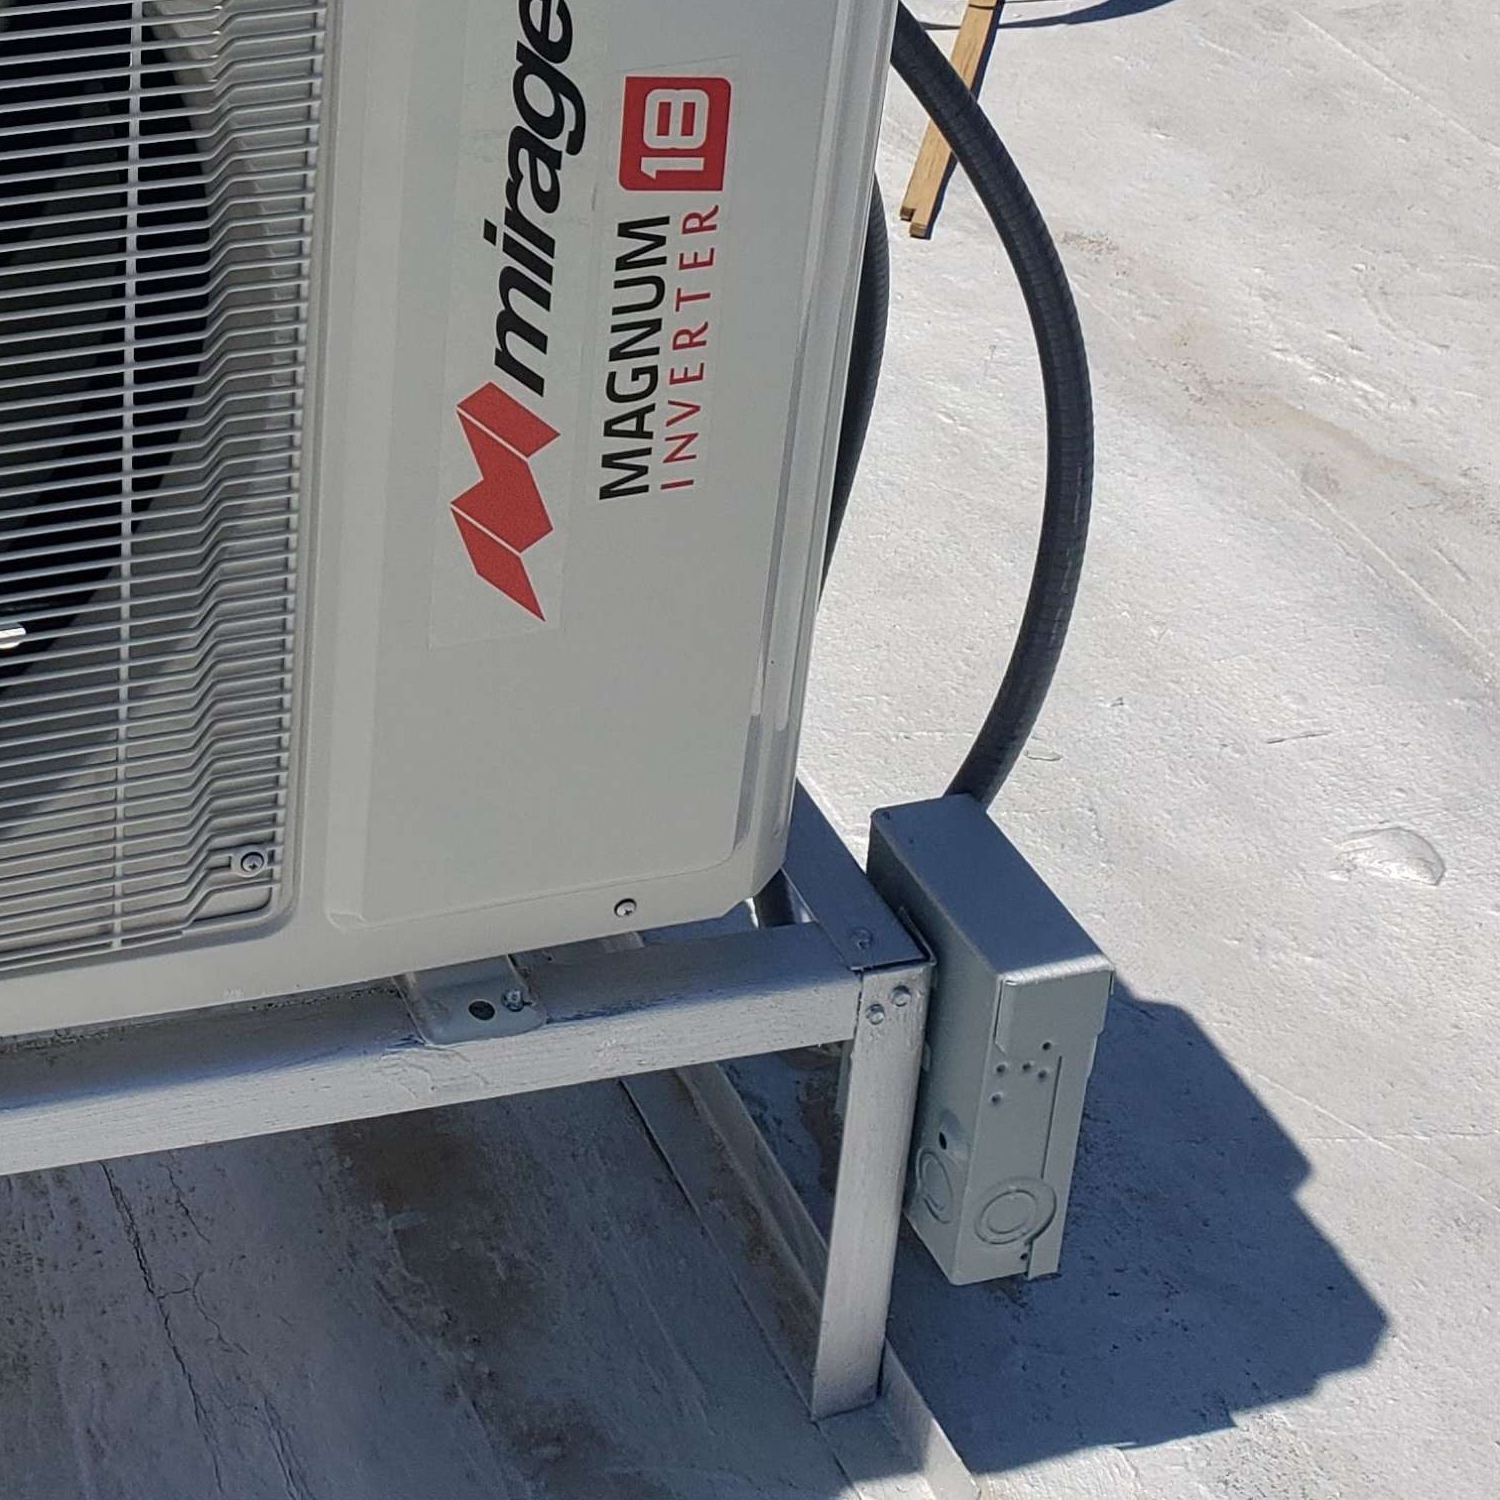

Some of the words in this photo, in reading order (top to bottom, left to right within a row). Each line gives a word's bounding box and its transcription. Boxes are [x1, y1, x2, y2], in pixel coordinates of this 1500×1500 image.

[639, 88, 709, 180] 18
[599, 215, 671, 501] MAGNUM
[661, 204, 720, 490] INVERTER
